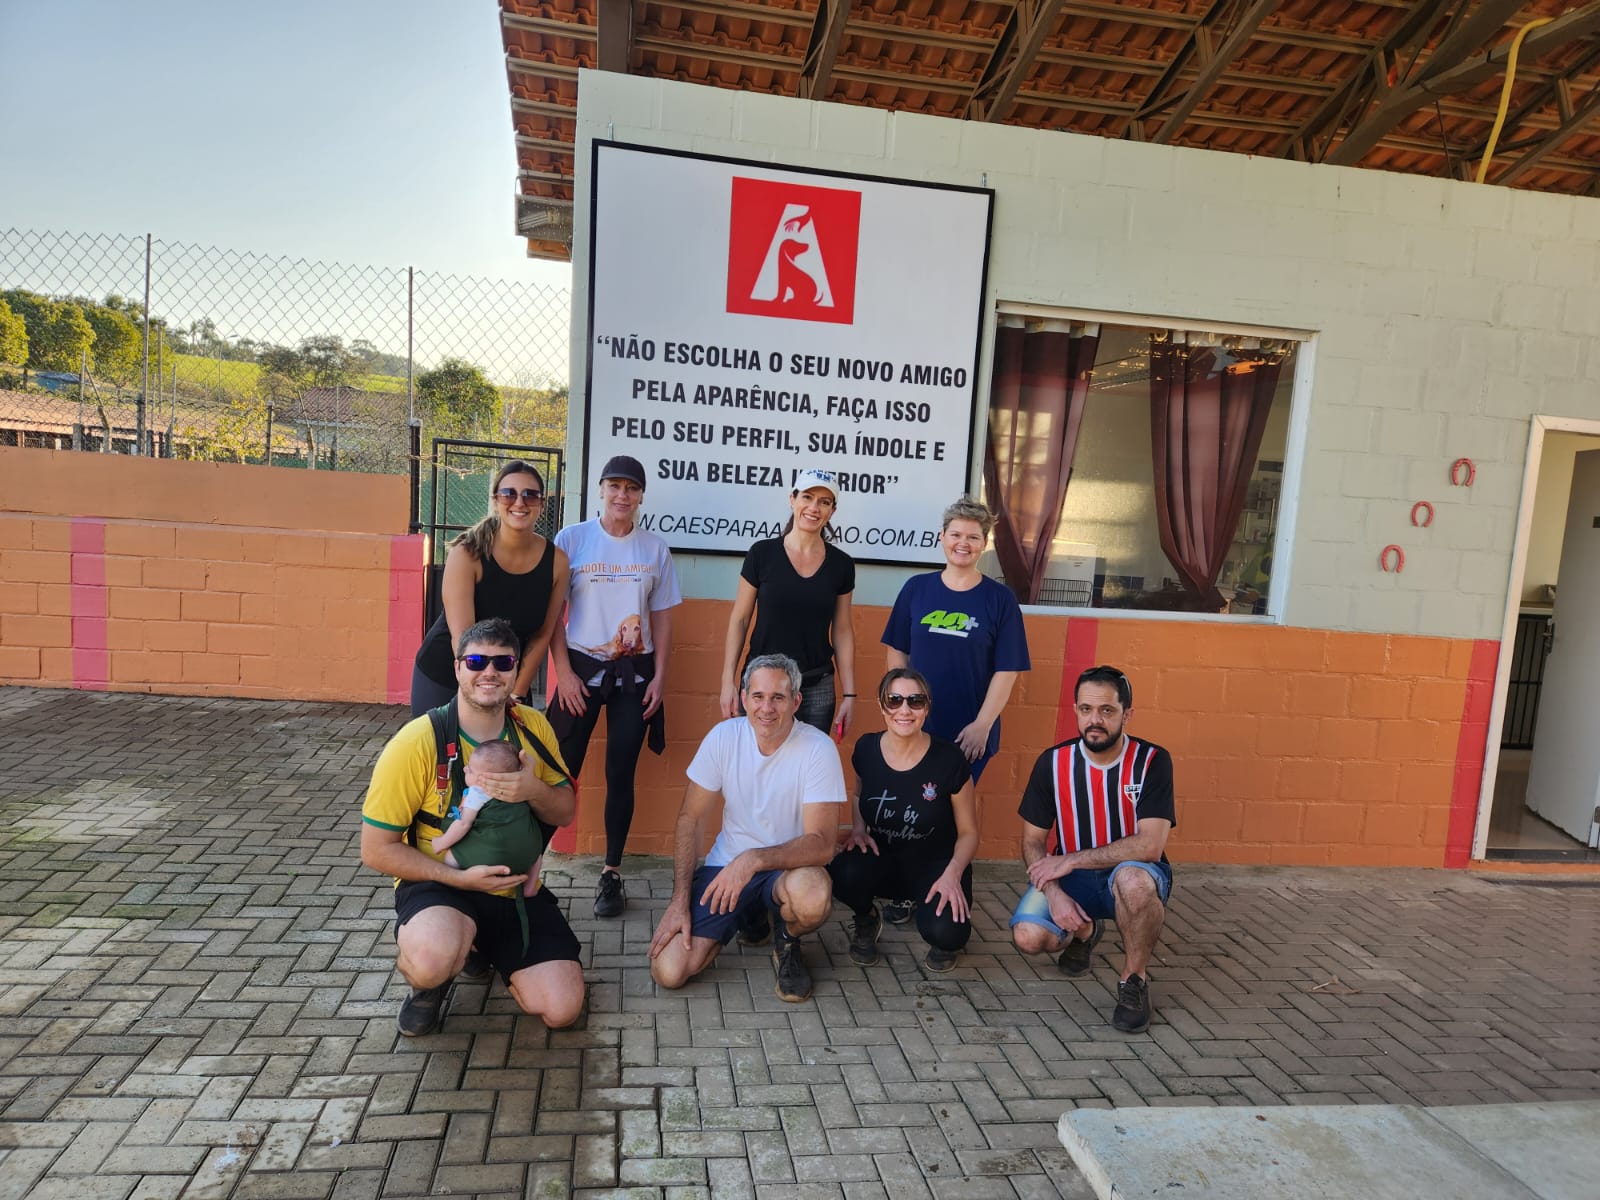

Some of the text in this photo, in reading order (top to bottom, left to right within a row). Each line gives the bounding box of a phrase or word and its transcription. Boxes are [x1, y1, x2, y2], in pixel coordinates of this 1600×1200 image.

[664, 342, 761, 371] ESCOLHA
[769, 352, 783, 373] O
[790, 354, 830, 377] SEU
[837, 358, 894, 382] NOVO
[900, 364, 967, 388] AMIGO
[632, 379, 931, 423] PELA APARÊNCIA, FAÇA ISSO
[611, 416, 946, 461] PELO SEU PERFIL, SUA ÍNDOLE E
[657, 458, 700, 482] SUA
[706, 462, 784, 488] BELEZA
[867, 789, 897, 825] Tu
